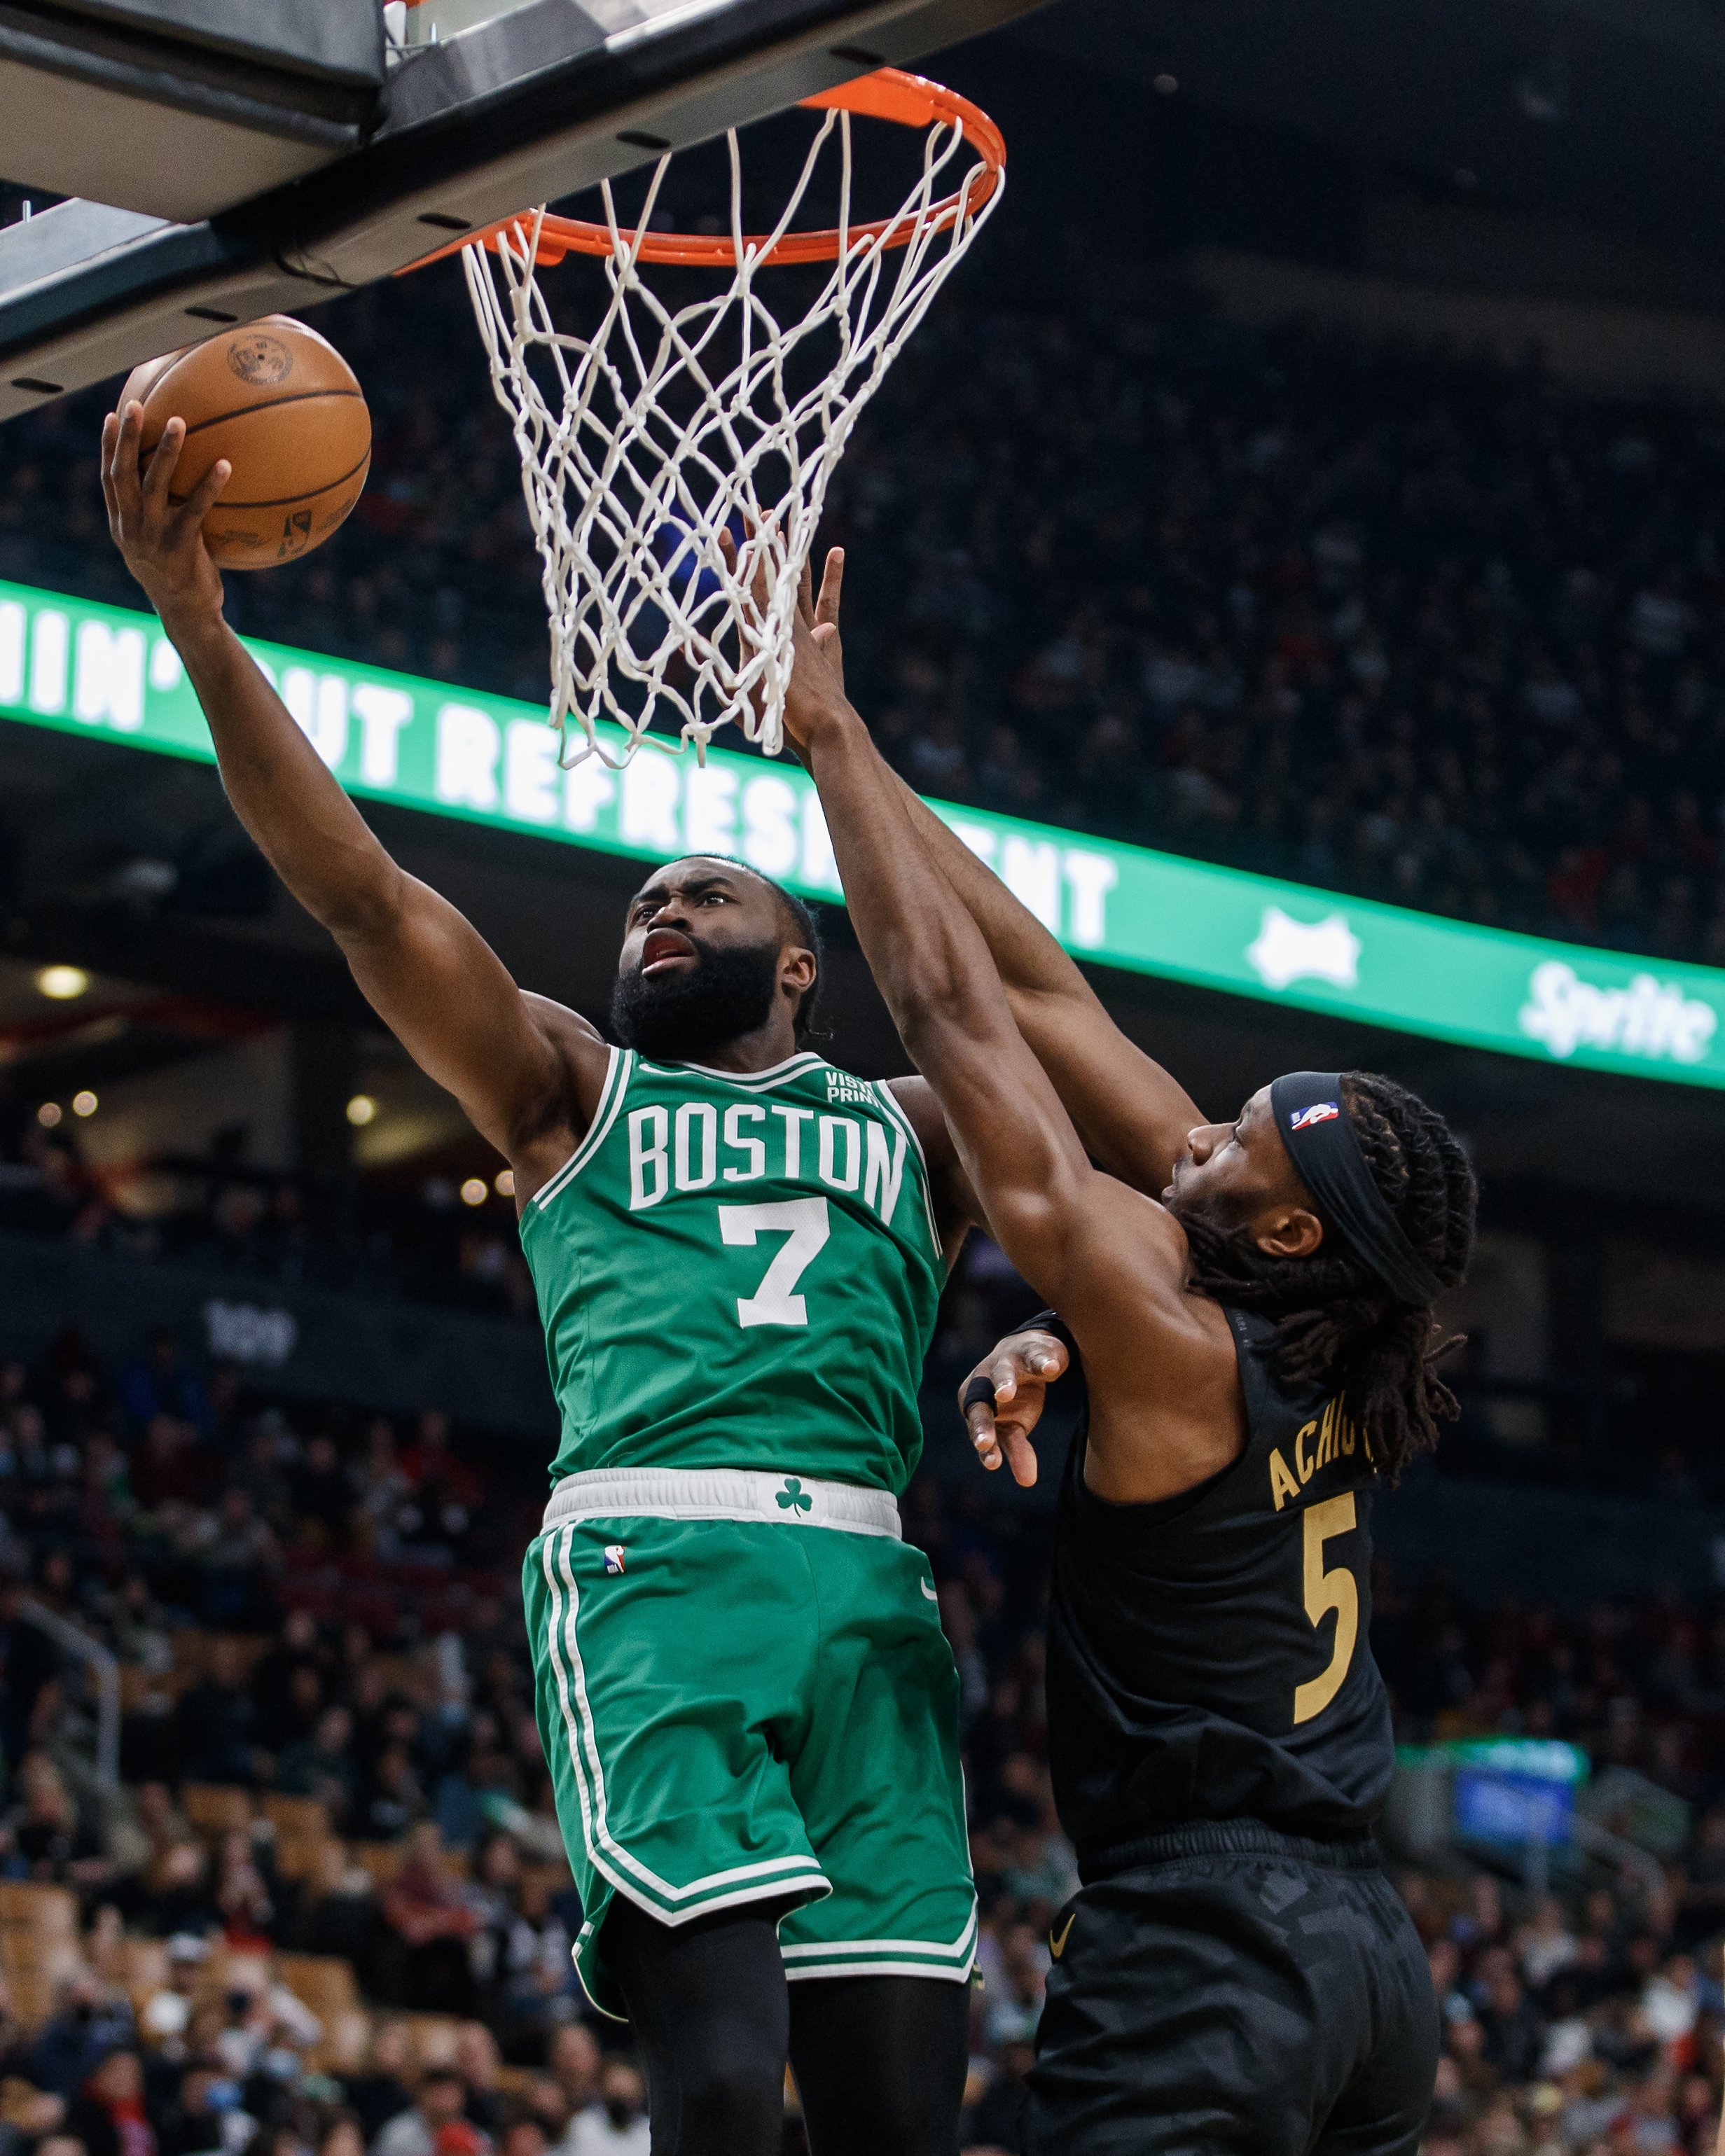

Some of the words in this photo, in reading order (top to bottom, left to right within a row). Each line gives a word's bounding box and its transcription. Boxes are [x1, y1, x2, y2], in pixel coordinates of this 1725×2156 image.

[254, 659, 415, 788] UT
[628, 1101, 906, 1227] BOSTON
[718, 1197, 831, 1328] 7
[1294, 1491, 1359, 1725] 5
